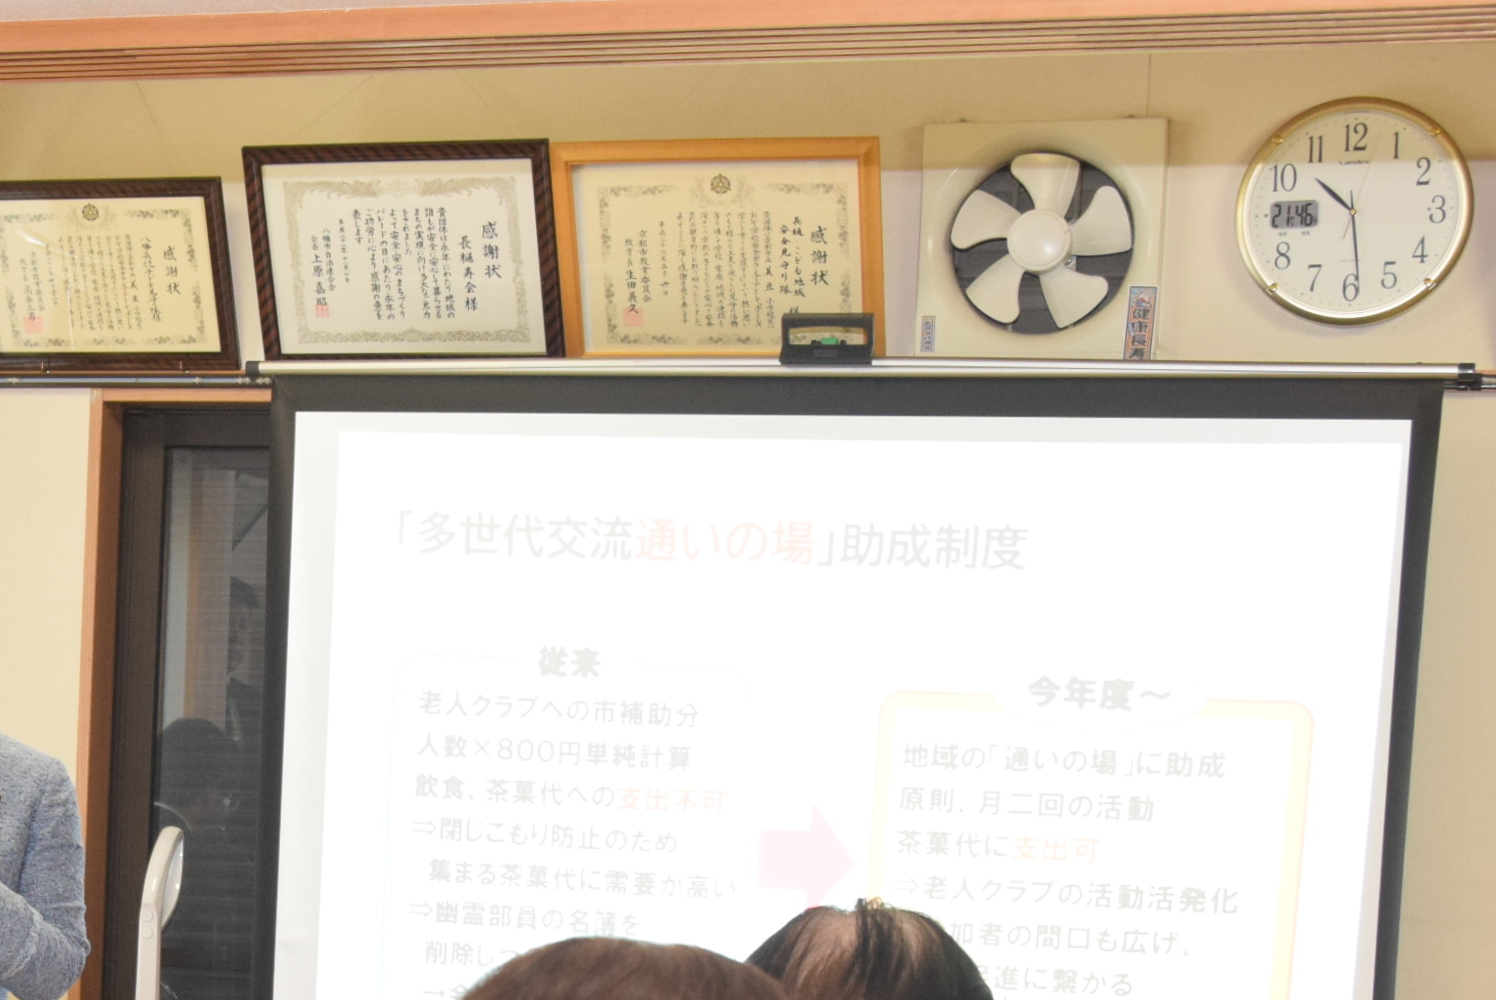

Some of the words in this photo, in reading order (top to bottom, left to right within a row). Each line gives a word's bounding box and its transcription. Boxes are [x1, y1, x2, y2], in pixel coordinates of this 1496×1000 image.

[1308, 135, 1324, 163] 11
[1345, 122, 1368, 151] 12
[1393, 131, 1400, 159] 1
[1271, 163, 1297, 192] 10
[1416, 157, 1432, 186] 2
[352, 208, 364, 244] 表します
[1429, 195, 1446, 223] 3
[401, 208, 413, 256] をされました
[481, 221, 502, 280] 感謝状
[1412, 236, 1428, 263] 4
[163, 246, 181, 295] 感謝状
[365, 208, 383, 321] ご功労に心より感謝の意を
[424, 207, 442, 320] 誰もが安全に安心して暮らせる
[437, 207, 455, 319] 貴団体は永年にわたり地域の
[458, 235, 479, 312] 長樋寿会様
[638, 229, 653, 303] 京都市教育委員会
[779, 224, 792, 296] 安全見守り隊
[810, 226, 830, 287] 感謝状
[1274, 242, 1291, 270] 8
[1307, 264, 1322, 292] 7
[1342, 274, 1359, 301] 6
[1381, 261, 1398, 289] 5
[397, 509, 1030, 572] 「多世代交流通いの場」助成制度
[537, 646, 601, 678] 従来
[419, 690, 700, 728] 老人クラブへの市補助分
[902, 743, 1227, 779] 地域の「通いの場」に助成
[415, 774, 727, 816] 飲食、茶菓代への支出不可
[899, 786, 1155, 823] 原則、月二回の活動
[439, 817, 677, 854] 閉じこもり防止のため
[896, 829, 1100, 864] 茶菓代に支出可
[923, 874, 1240, 915] 老人クラブの活動活発化
[435, 900, 640, 936] 幽霊部員の名簿を
[949, 920, 1191, 958] 加者の間口も広げ、
